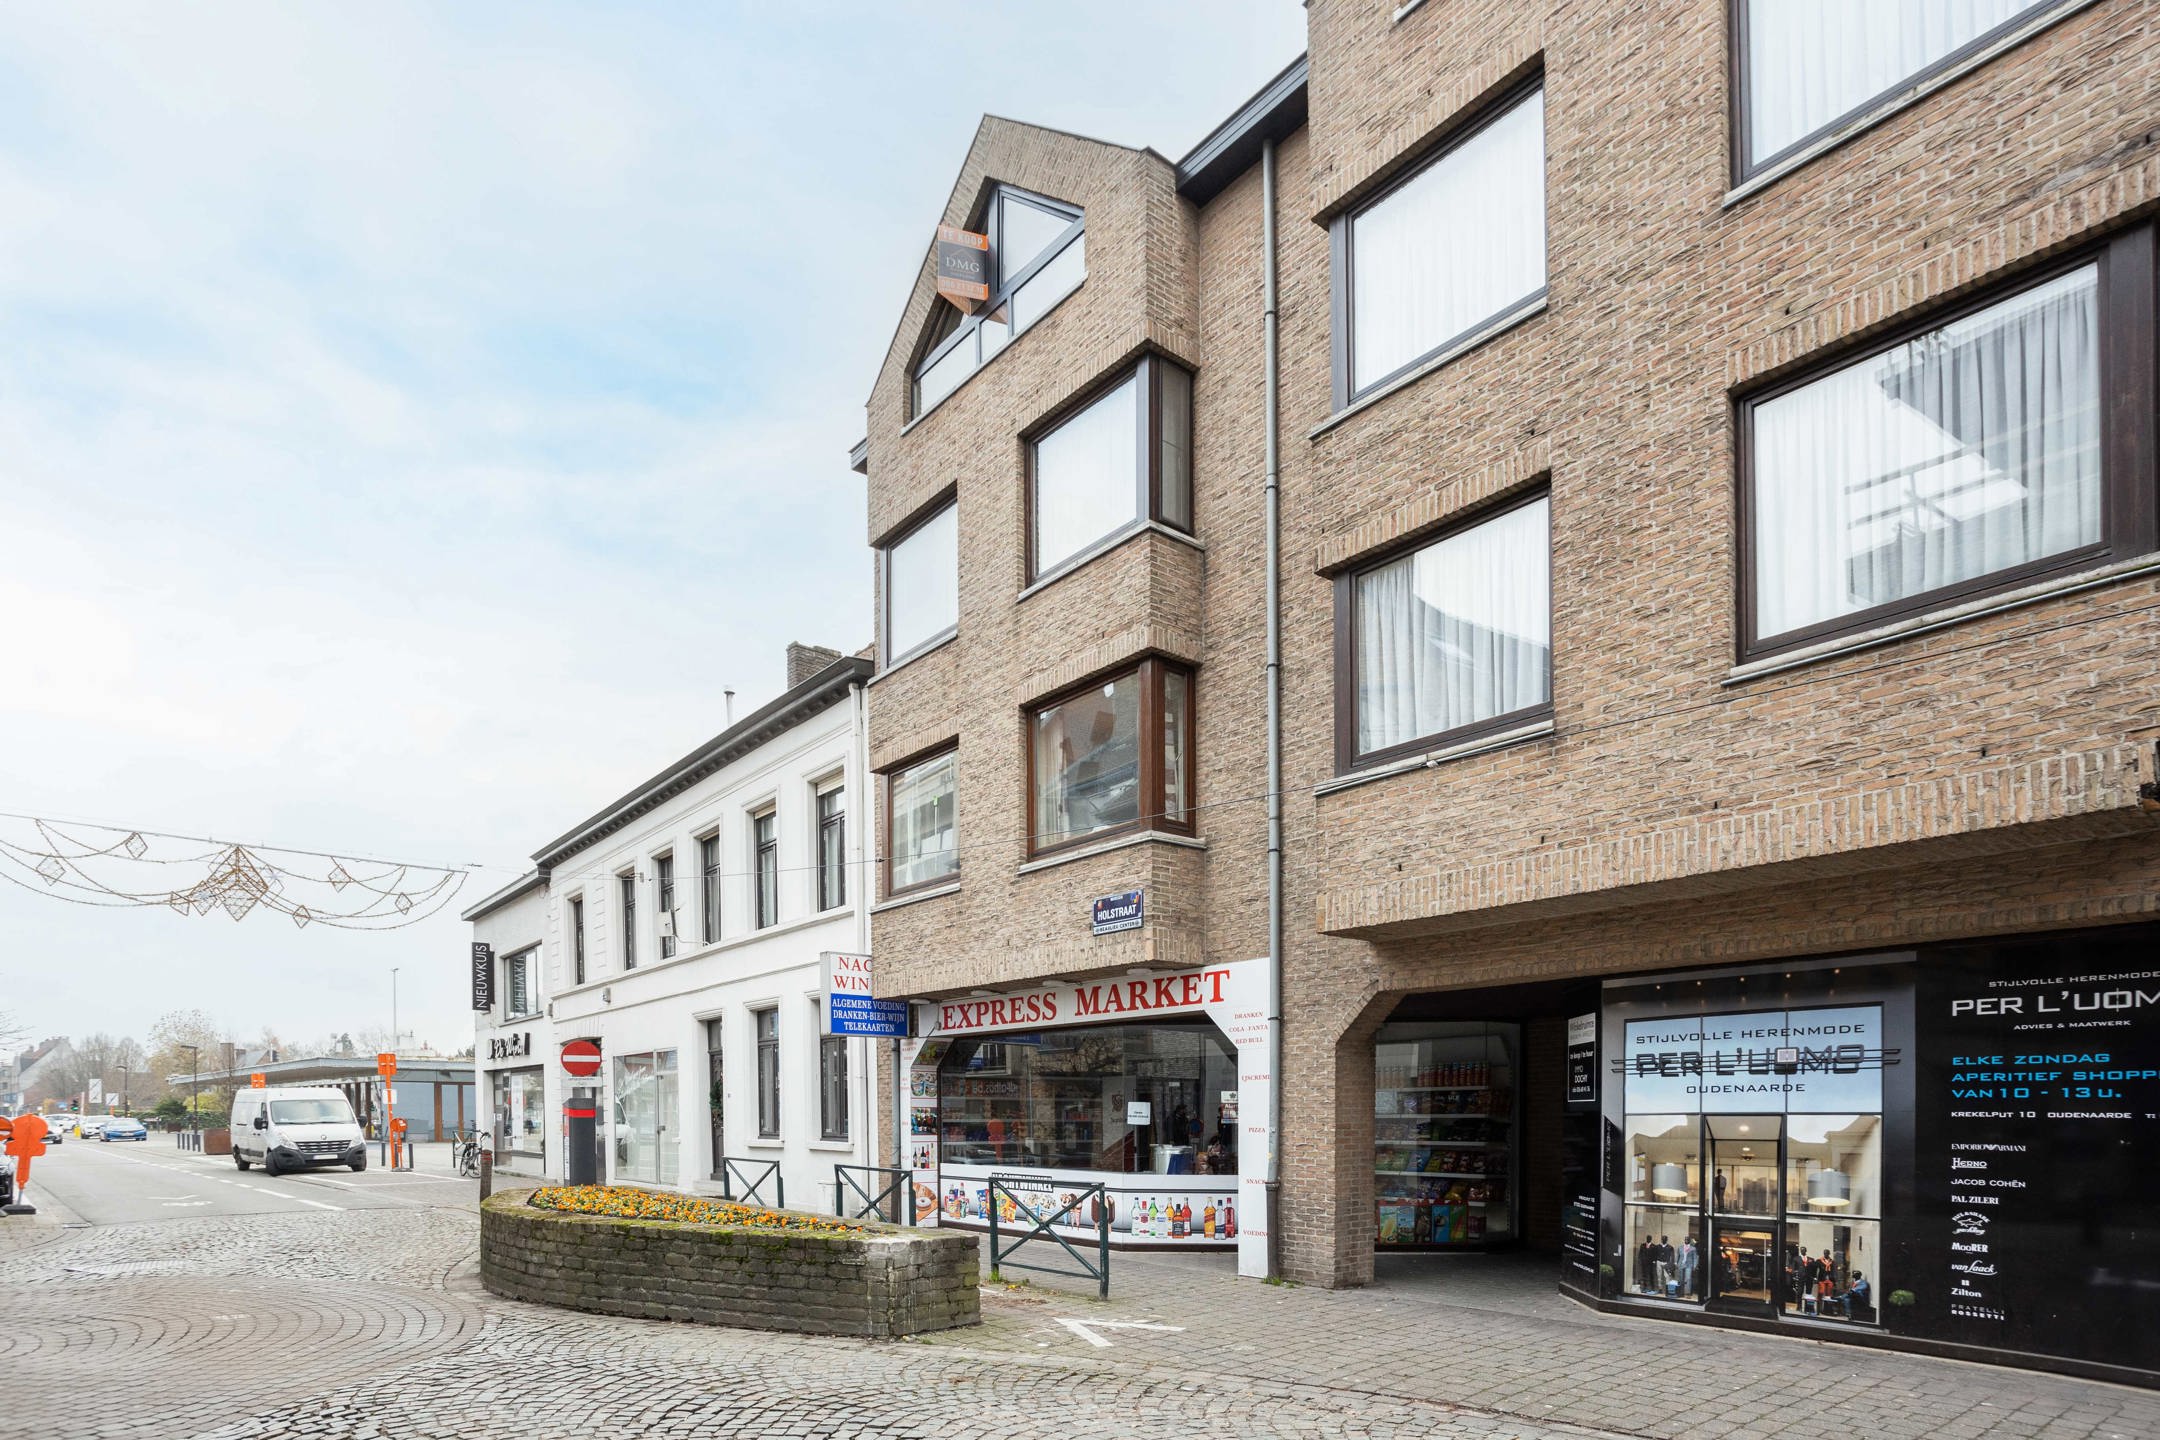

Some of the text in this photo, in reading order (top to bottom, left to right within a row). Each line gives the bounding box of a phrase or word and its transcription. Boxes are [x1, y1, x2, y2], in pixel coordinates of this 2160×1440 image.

[945, 256, 980, 273] DMG
[1097, 904, 1136, 921] HOLSTRAAT
[475, 945, 488, 1008] NIEUWKUIS
[833, 975, 869, 990] WIN
[1989, 971, 2160, 988] STIJLVOLLE HERENMODE
[832, 998, 905, 1011] ALGEMENE VOEDING
[942, 969, 1230, 1031] EXPRESS MARKET
[1952, 997, 2024, 1017] PER
[844, 1021, 895, 1033] TELEKAARTEN
[1247, 1024, 1269, 1032] FANTA
[2013, 1023, 2053, 1031] ADVIES
[2069, 1020, 2132, 1028] MAATWERK
[1636, 1024, 1865, 1044] STIJLVOLLE HERENMODE
[1636, 1052, 1700, 1075] PER
[1952, 1053, 2111, 1066] ELKE ZONDAG
[1951, 1072, 2062, 1082] APERITIEF
[1686, 1083, 1806, 1094] OUDENAARDE
[1952, 1089, 1993, 1098] VAN
[1999, 1087, 2030, 1098] 10
[2061, 1087, 2092, 1098] 13
[2047, 1111, 2132, 1119] OUDENAARDE
[1951, 1195, 2000, 1204] PAL ZILERI
[1964, 1260, 1998, 1275] Laack
[1951, 1287, 1982, 1298] Zilton
[1951, 1304, 2004, 1314] FRATELLI
[1951, 1310, 2004, 1320] ROSSETTI
